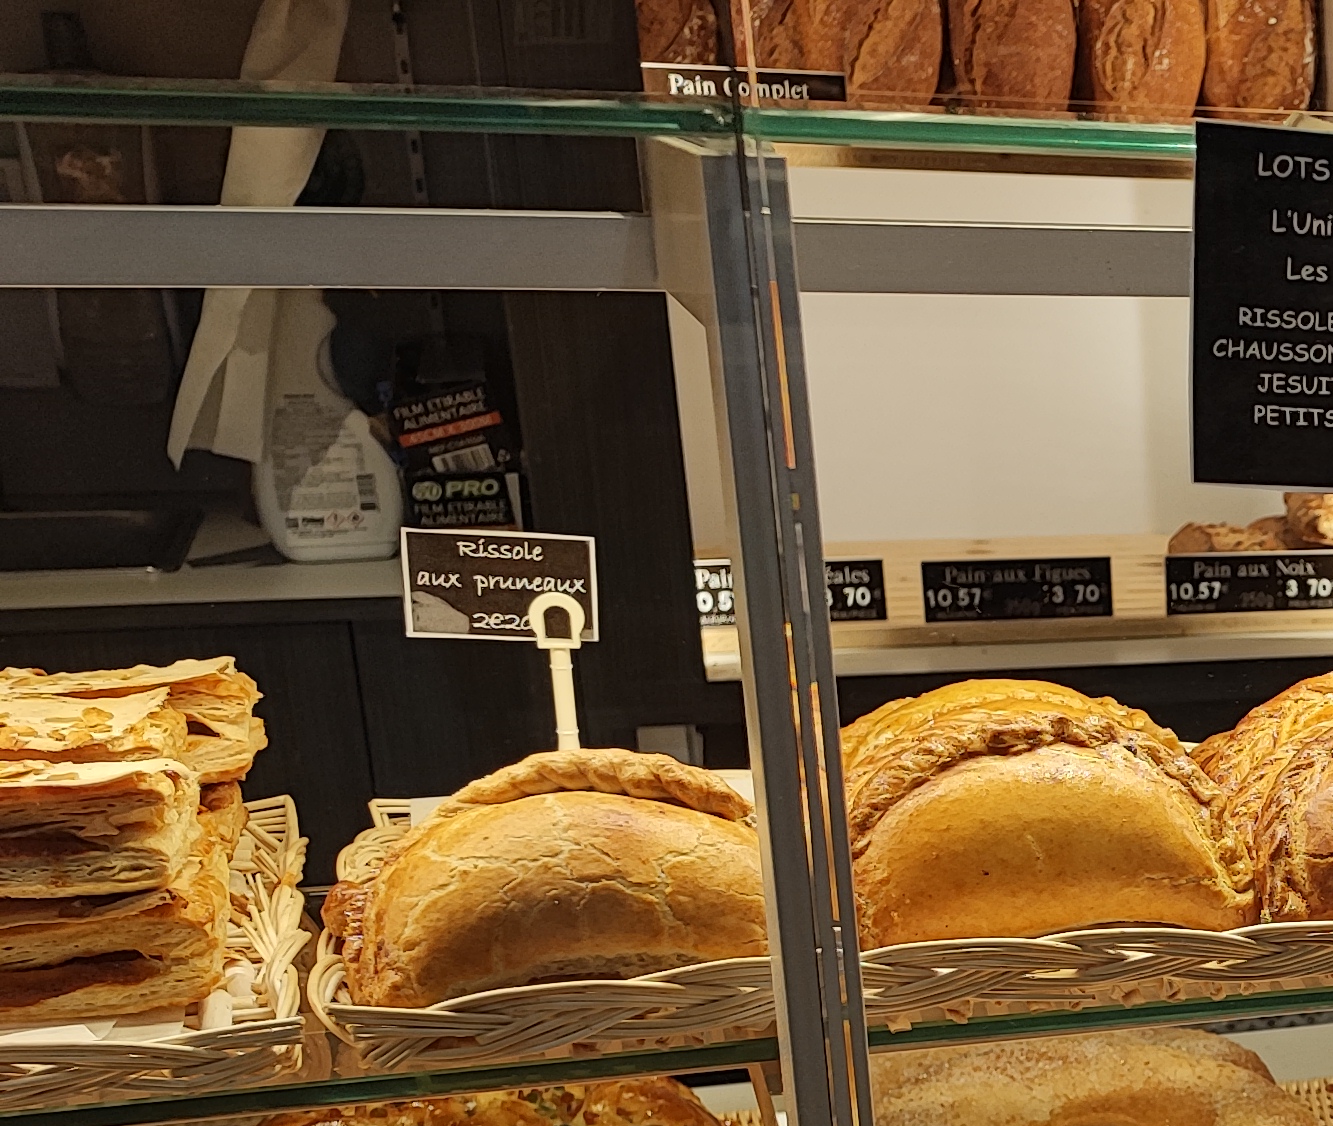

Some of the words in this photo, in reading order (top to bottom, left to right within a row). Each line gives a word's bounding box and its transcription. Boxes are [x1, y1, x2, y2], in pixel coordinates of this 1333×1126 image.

[667, 73, 717, 96] Pain
[723, 77, 810, 100] Complet
[1258, 152, 1331, 181] LOTS
[1286, 256, 1328, 283] Les
[445, 478, 500, 499] PRO
[456, 538, 544, 561] Rissole
[945, 566, 986, 584] Pain
[993, 567, 1027, 584] aux
[1193, 561, 1232, 579] Pain
[1237, 563, 1270, 578] aux
[1276, 558, 1316, 577] Noix
[416, 570, 463, 588] aux
[473, 574, 588, 597] pruneaux
